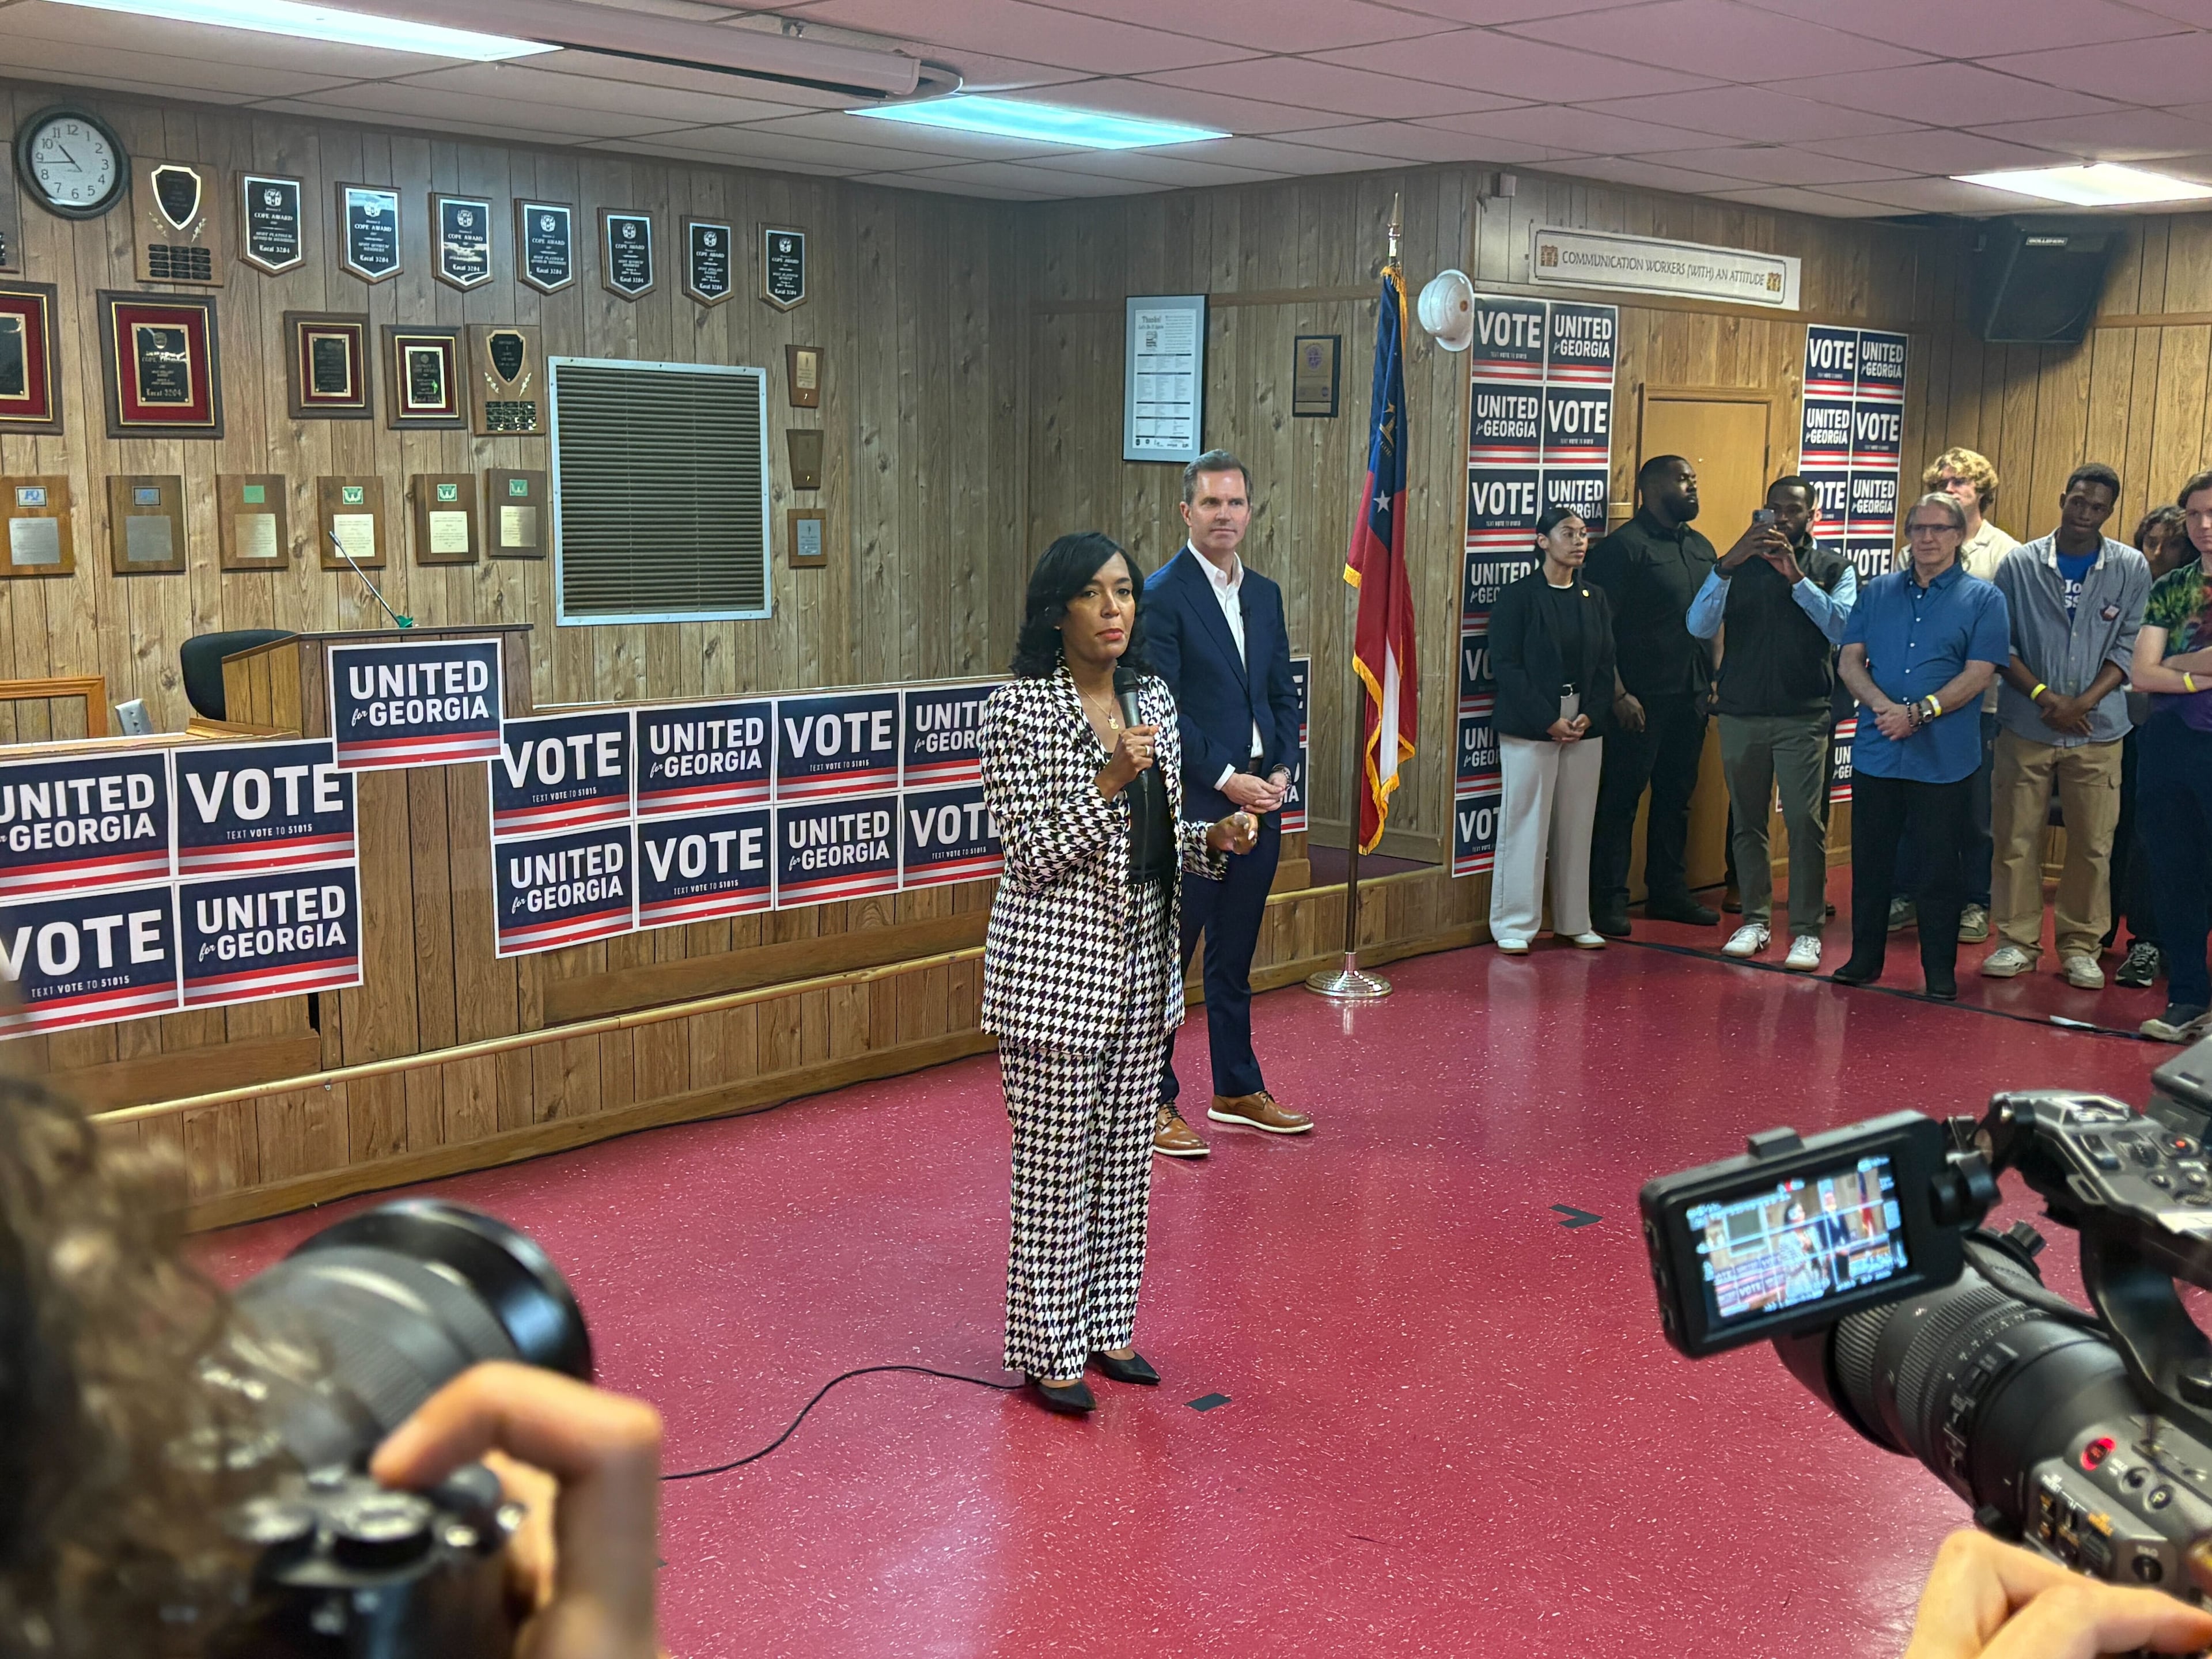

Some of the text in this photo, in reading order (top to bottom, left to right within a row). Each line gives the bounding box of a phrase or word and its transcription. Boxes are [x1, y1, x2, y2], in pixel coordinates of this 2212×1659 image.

[52, 127, 61, 138] 11
[67, 124, 79, 135] 12
[87, 131, 90, 141] 1
[42, 138, 53, 149] 10
[95, 143, 103, 154] 2
[36, 152, 44, 162] 9
[101, 159, 109, 170] 3
[41, 169, 49, 180] 8
[98, 174, 105, 184] 4
[54, 183, 62, 193] 7
[71, 188, 79, 199] 6
[88, 185, 96, 196] 5
[1562, 250, 1765, 286] COMMUNICATION WORKERS (WITH) AN ATTITUDE
[1478, 310, 1541, 348] VOTE
[1555, 315, 1612, 340] UNITED
[1560, 339, 1611, 358] GEORGIA
[1809, 338, 1855, 370] VOTE
[1862, 341, 1904, 363] UNITED
[1866, 362, 1902, 378] GEORGIA
[1478, 395, 1538, 419] UNITED
[1548, 400, 1607, 433] VOTE
[1806, 408, 1850, 429] UNITED
[1484, 420, 1536, 437] GEORGIA
[1810, 429, 1848, 444] GEORGIA
[1857, 412, 1900, 442] VOTE
[1472, 482, 1535, 515] VOTE
[1548, 480, 1604, 502] UNITED
[1809, 481, 1846, 509] OTE
[1853, 479, 1895, 498] UNITED
[1857, 499, 1893, 514] GEORGIA
[349, 660, 488, 700] UNITED
[351, 695, 489, 727] for GEORGIA
[649, 717, 764, 755] UNITED
[783, 710, 893, 759] VOTE
[926, 730, 981, 753] GEOR
[503, 731, 622, 789] VOTE
[649, 748, 763, 779] for GEORGIA
[810, 764, 824, 772] TEXT
[825, 762, 841, 770] VOTE
[851, 759, 870, 767] 51015
[0, 774, 155, 824] UNITED
[185, 763, 344, 823] VOTE
[532, 787, 597, 804] TEXT VOTE TO 51015
[9, 812, 157, 852] GEORGIA
[226, 824, 313, 840] TEXT VOTE TO 51015
[789, 810, 891, 849] UNITED
[510, 842, 624, 889] UNITED
[645, 827, 764, 883] VOTE
[789, 840, 891, 872] for GEORGIA
[512, 875, 624, 914] for GEORGIA
[673, 886, 689, 895] TEXT
[690, 884, 708, 893] VOTE
[718, 879, 739, 889] 51015
[196, 885, 346, 934] UNITED
[0, 909, 165, 982] VOTE
[198, 922, 347, 963] for GEORGIA
[31, 975, 130, 998] TEXT VOTE TO 51015
